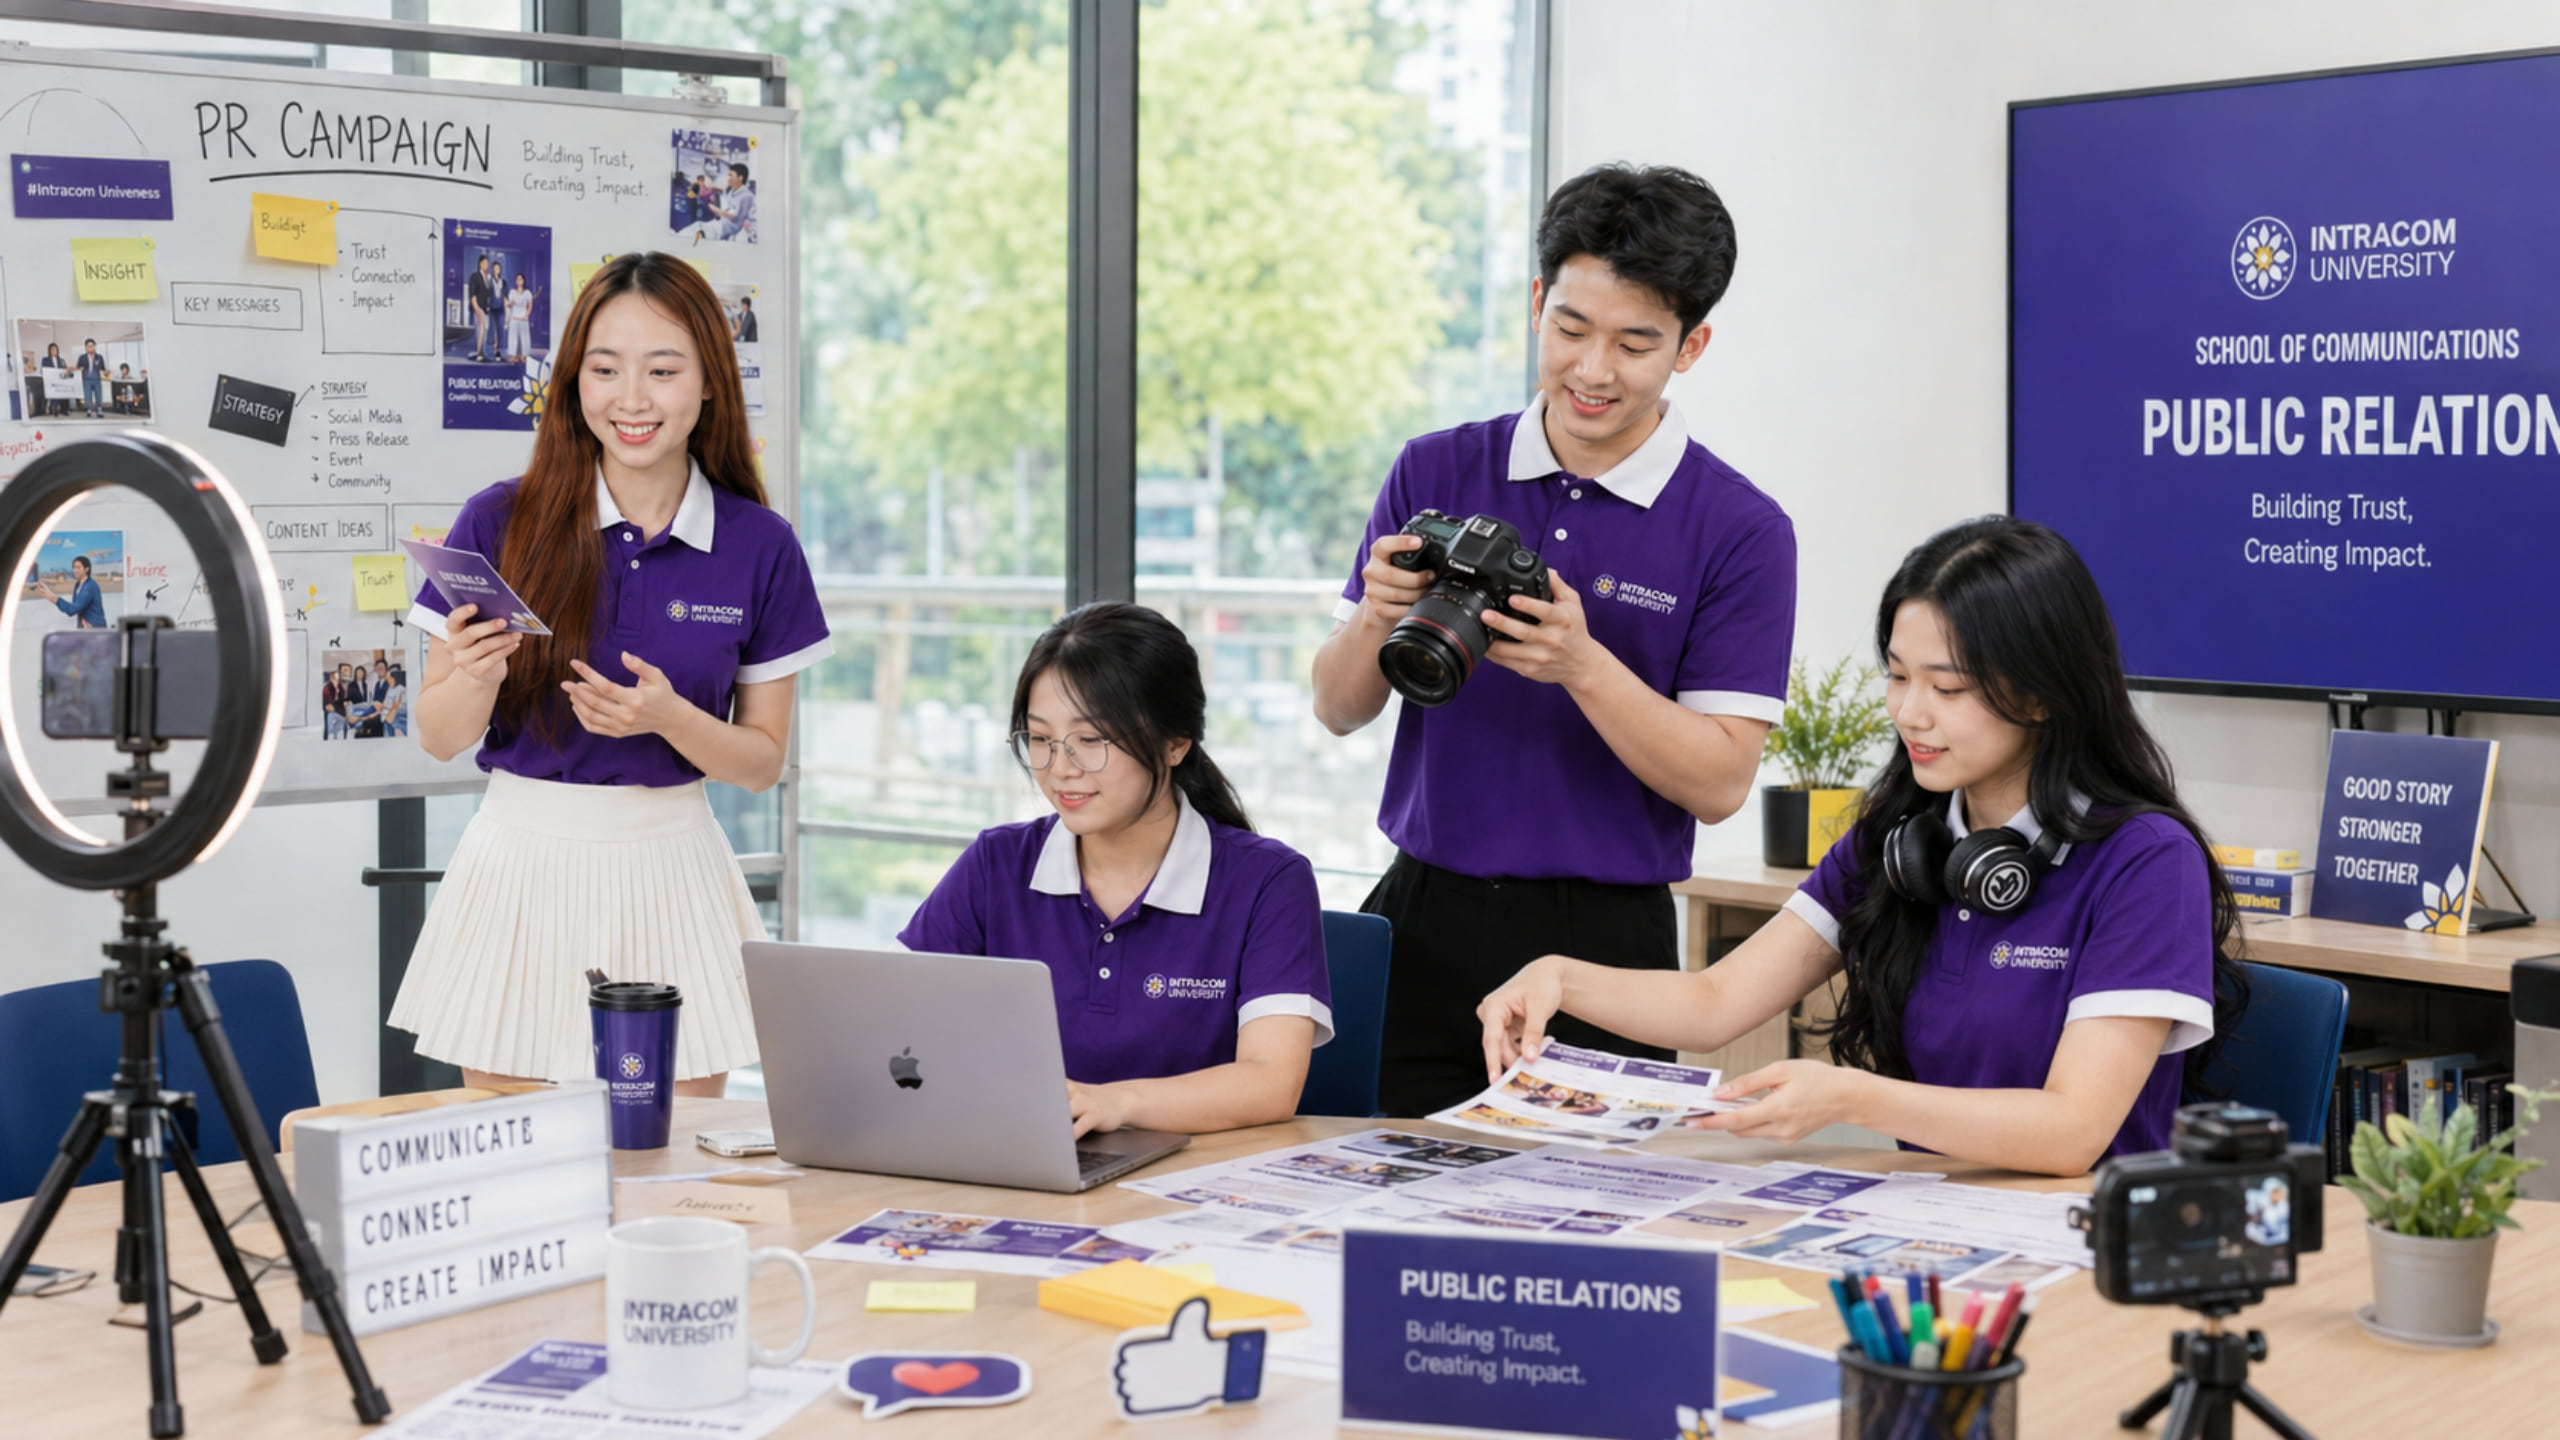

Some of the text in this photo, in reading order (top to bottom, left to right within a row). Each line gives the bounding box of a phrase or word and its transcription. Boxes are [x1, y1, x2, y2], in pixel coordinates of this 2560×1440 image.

[194, 101, 491, 174] PR CAMPAIGN
[522, 140, 635, 172] Building Trust,
[27, 183, 161, 200] #Intracom Univeness
[523, 173, 649, 203] Creating Impact.
[2310, 218, 2457, 252] INTRACOM
[351, 243, 387, 260] Trust
[2309, 250, 2456, 282] UNIVERSITY
[83, 259, 147, 281] INSIGHT
[351, 267, 416, 284] Connection
[184, 297, 281, 313] KEY MESSAGES
[352, 292, 394, 310] Impact
[2195, 328, 2520, 365] SCHOOL OF COMMUNICATIONS
[321, 381, 368, 396] STRATEGY
[222, 393, 285, 425] STRATEGY
[328, 409, 403, 425] Social Media
[328, 432, 410, 447] Press Release
[2143, 393, 2560, 456] PUBLIC RELATION
[329, 452, 363, 467] Event
[328, 473, 392, 494] Community
[2251, 493, 2414, 526] Building Trust,
[266, 519, 374, 540] CONTENT IDEAS
[2244, 537, 2432, 572] Creating Impact.
[1620, 581, 1678, 605] INTRACOM
[2343, 776, 2453, 806] GOOD STORY
[2338, 816, 2423, 845] STRONGER
[2334, 855, 2419, 886] TOGETHER
[1168, 978, 1227, 989] INTRACOM
[359, 1115, 535, 1176] COMMUNICATE
[361, 1195, 471, 1246] CONNECT
[364, 1238, 566, 1314] CREATE IMPACT
[1400, 1268, 1683, 1315] PUBLIC RELATIONS
[623, 1296, 740, 1325] INTRACOM
[623, 1322, 738, 1347] UNIVERSITY
[1405, 1319, 1561, 1355] Building Trust,
[1404, 1350, 1587, 1387] Creating Impact.
